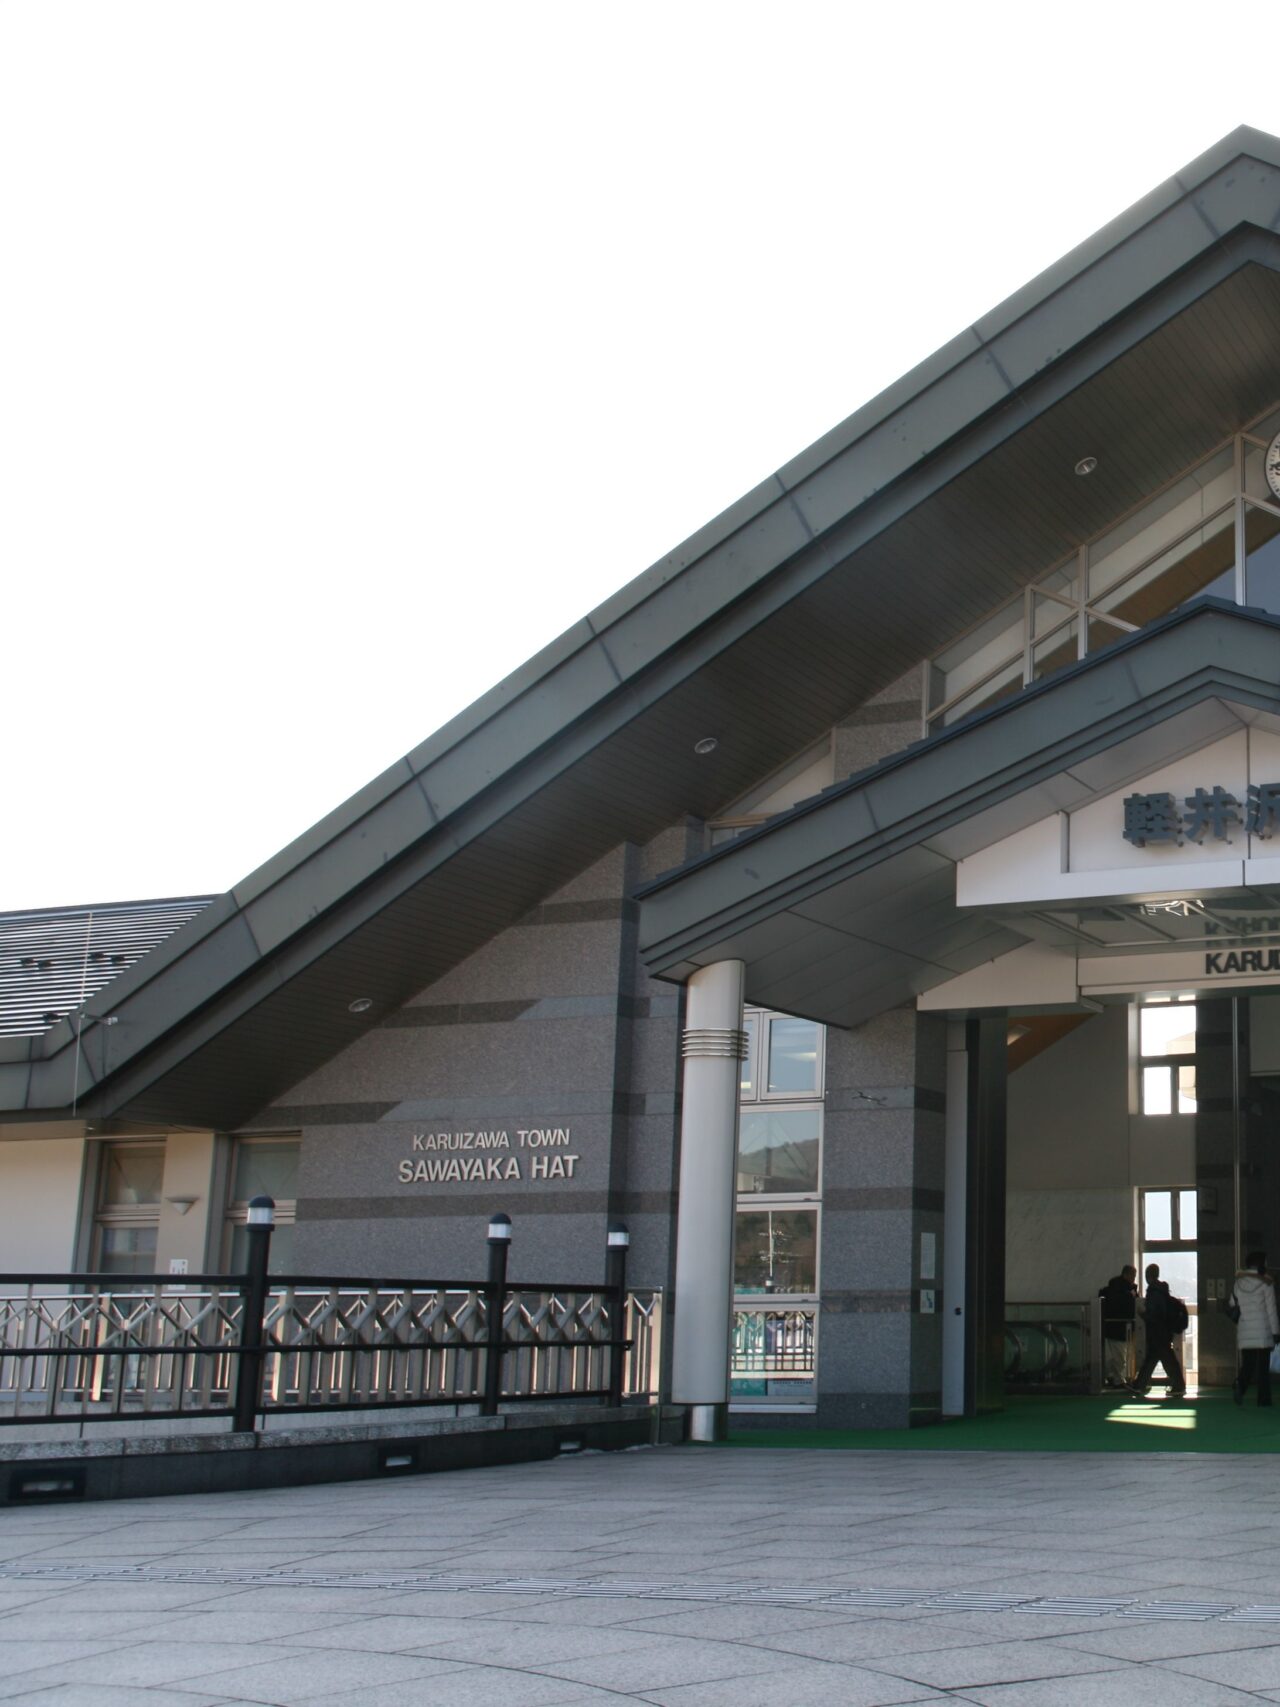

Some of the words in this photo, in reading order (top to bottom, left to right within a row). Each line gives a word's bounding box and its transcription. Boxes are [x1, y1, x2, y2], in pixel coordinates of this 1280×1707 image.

[413, 1131, 509, 1151] KARUIZAWA
[517, 1128, 570, 1148] TOWN
[399, 1157, 521, 1183] SAWAYAKA
[531, 1155, 579, 1179] HAT
